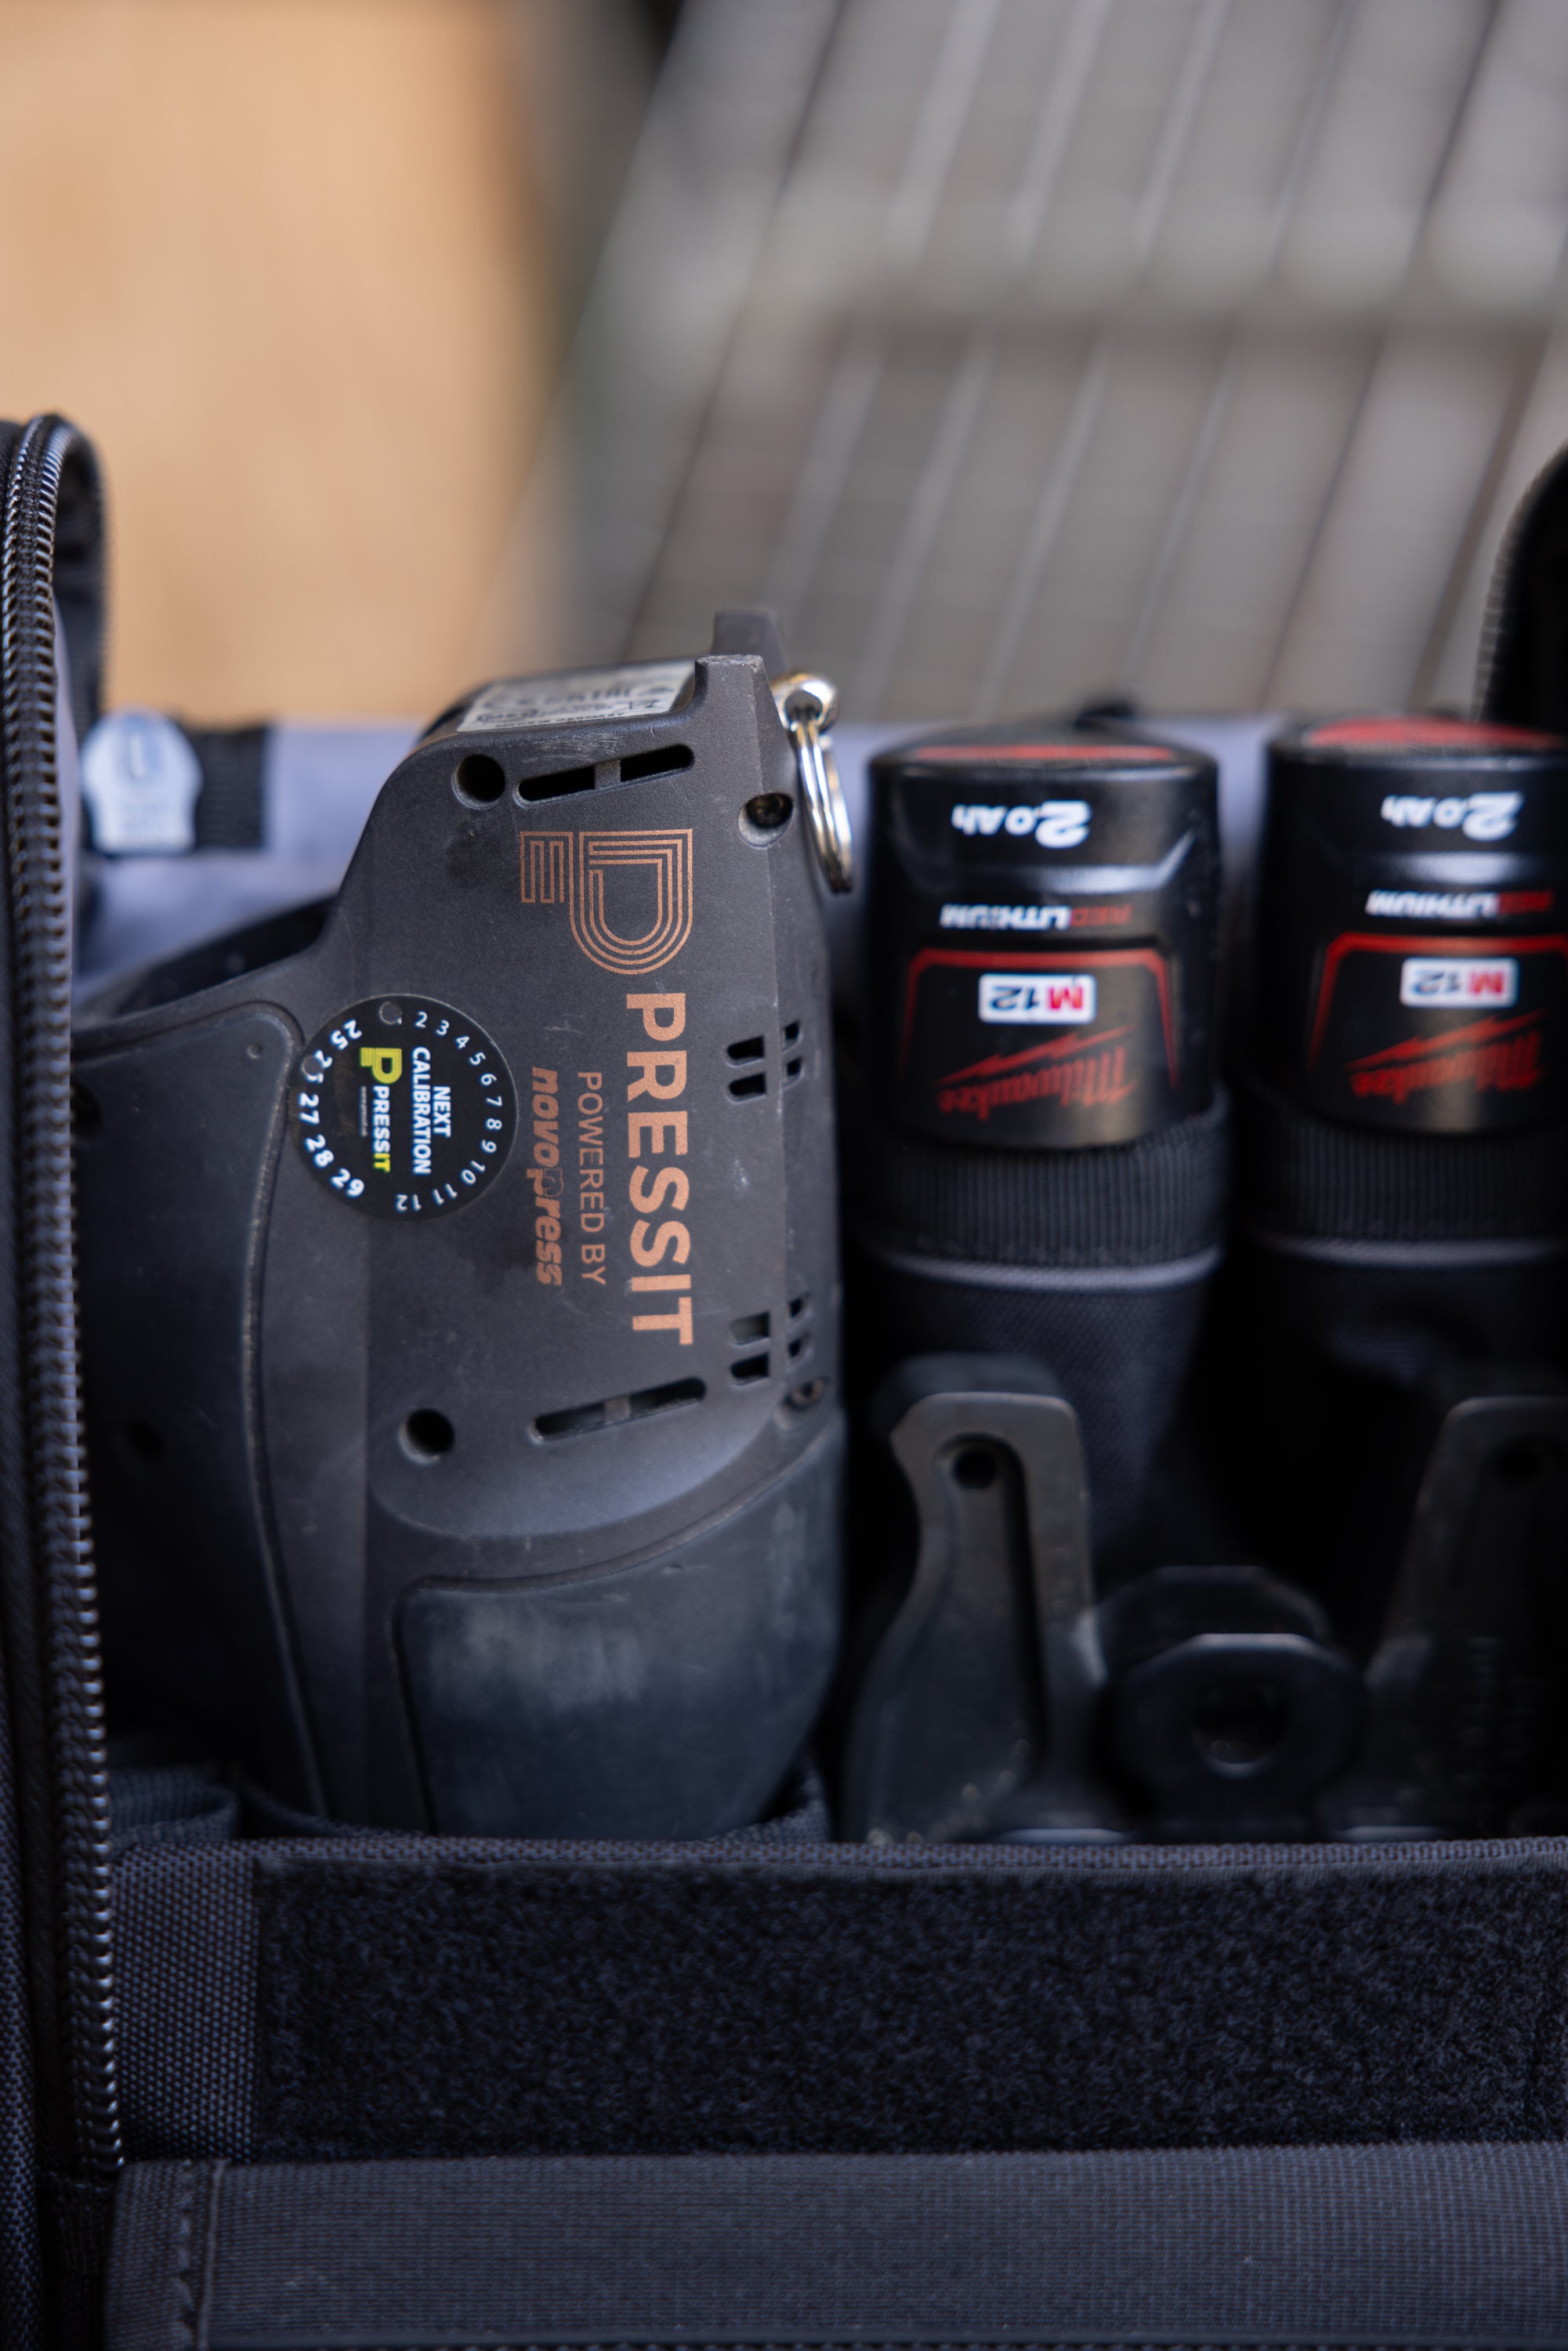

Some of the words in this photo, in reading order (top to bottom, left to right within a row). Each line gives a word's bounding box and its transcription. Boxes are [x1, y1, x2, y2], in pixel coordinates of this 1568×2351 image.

[1413, 969, 1506, 996] M12
[990, 985, 1085, 1011] M12
[415, 1011, 428, 1028] 2
[436, 1020, 450, 1036] 3
[330, 1020, 362, 1051] 25
[455, 1035, 469, 1049] 4
[469, 1052, 486, 1066] 5
[480, 1073, 497, 1086] 6
[937, 1045, 1137, 1121] Milwaukee
[299, 1092, 320, 1125] 27
[412, 1047, 431, 1175] CALIBRATION
[432, 1085, 451, 1138] NEXT
[486, 1096, 502, 1107] 7
[372, 1085, 390, 1172] PRESSIT
[485, 1118, 502, 1130] 8
[305, 1134, 335, 1168] 28
[480, 1139, 497, 1154] 9
[577, 1070, 605, 1233] POWERED
[331, 1168, 365, 1197] 29
[460, 1160, 486, 1185] 10
[527, 1066, 564, 1286] novopress
[626, 992, 693, 1346] PRESSIT
[395, 1194, 422, 1212] 12
[433, 1183, 458, 1205] 11
[581, 1243, 607, 1286] BY
